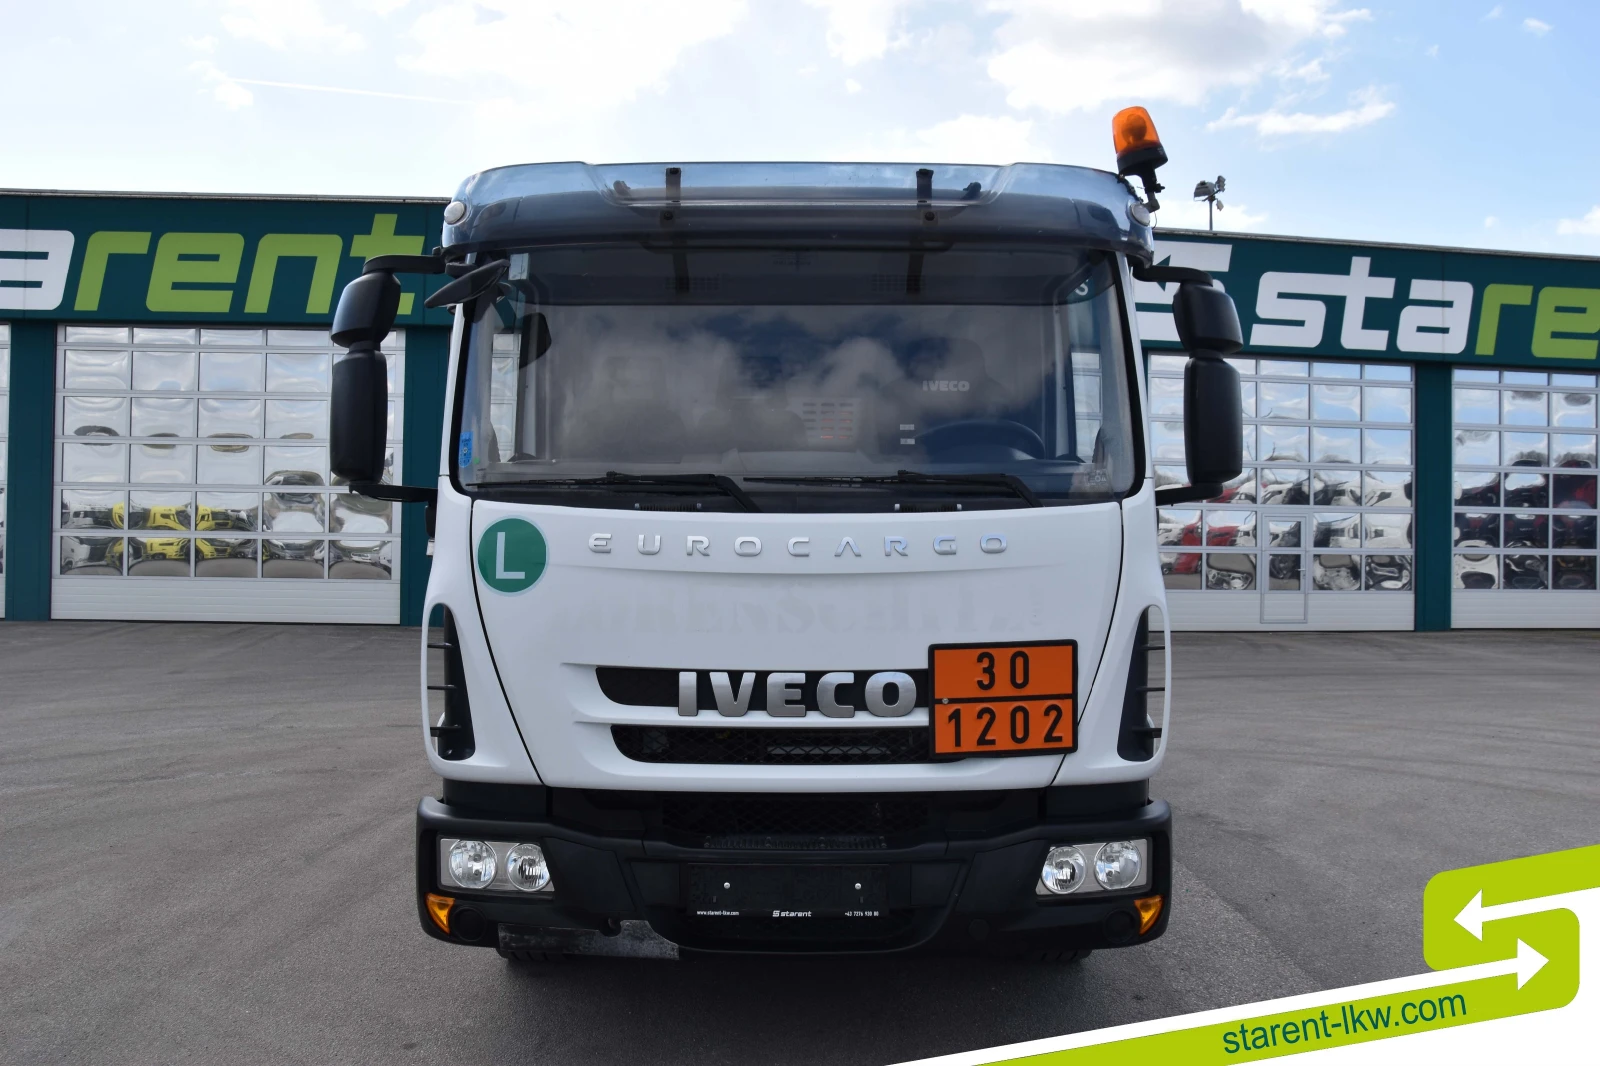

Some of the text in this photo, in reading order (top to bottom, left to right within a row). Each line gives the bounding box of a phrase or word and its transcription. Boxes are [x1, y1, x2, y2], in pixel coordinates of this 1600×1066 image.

[922, 380, 970, 392] IVECO
[495, 531, 526, 579] L
[588, 532, 1009, 557] EUROCARGO
[976, 650, 1031, 691] 30
[677, 671, 918, 718] IVECO
[947, 703, 1064, 747] 1202
